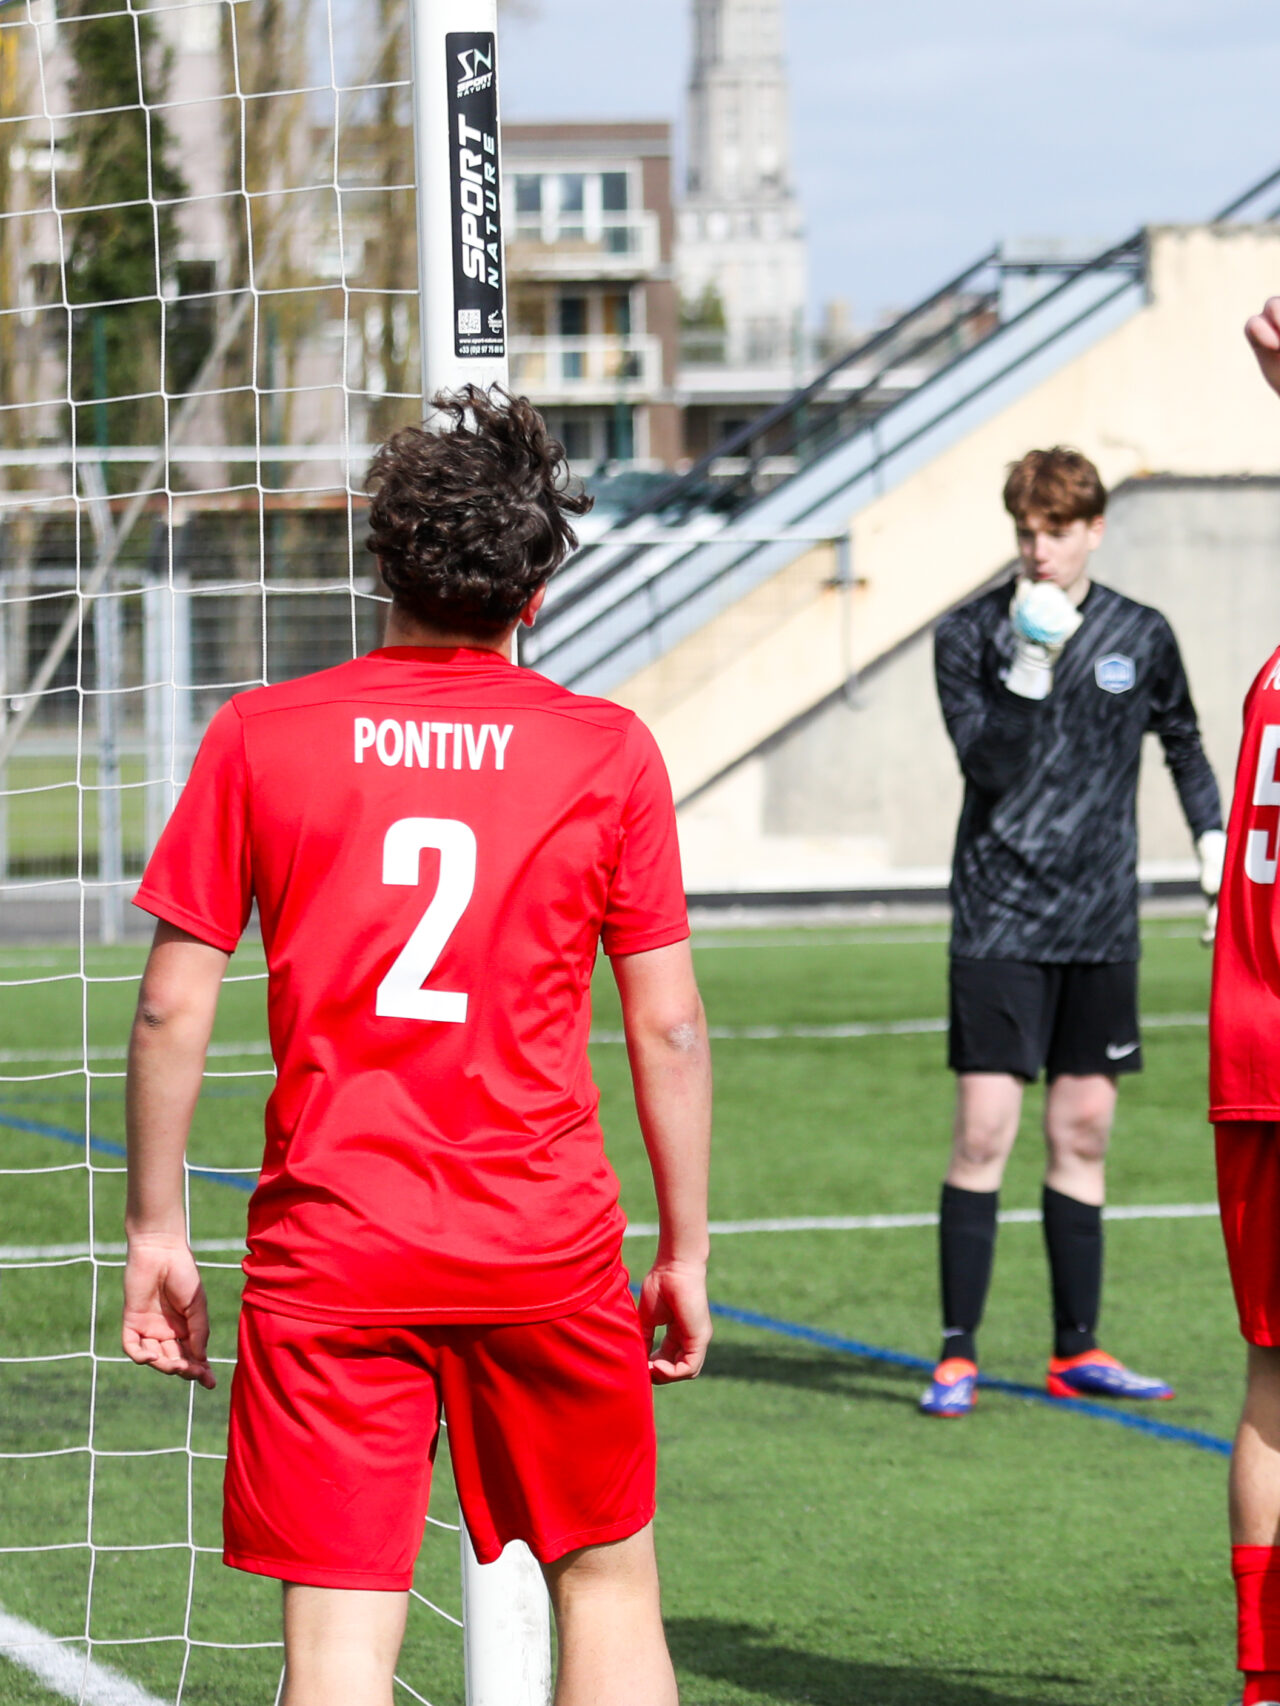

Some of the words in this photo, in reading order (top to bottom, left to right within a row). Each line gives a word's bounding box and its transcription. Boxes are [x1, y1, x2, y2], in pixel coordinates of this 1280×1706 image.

[457, 72, 493, 92] SPORT
[458, 113, 486, 283] SPORT
[483, 132, 499, 289] NATURE
[354, 717, 515, 770] PONTIVY
[375, 817, 477, 1023] 2
